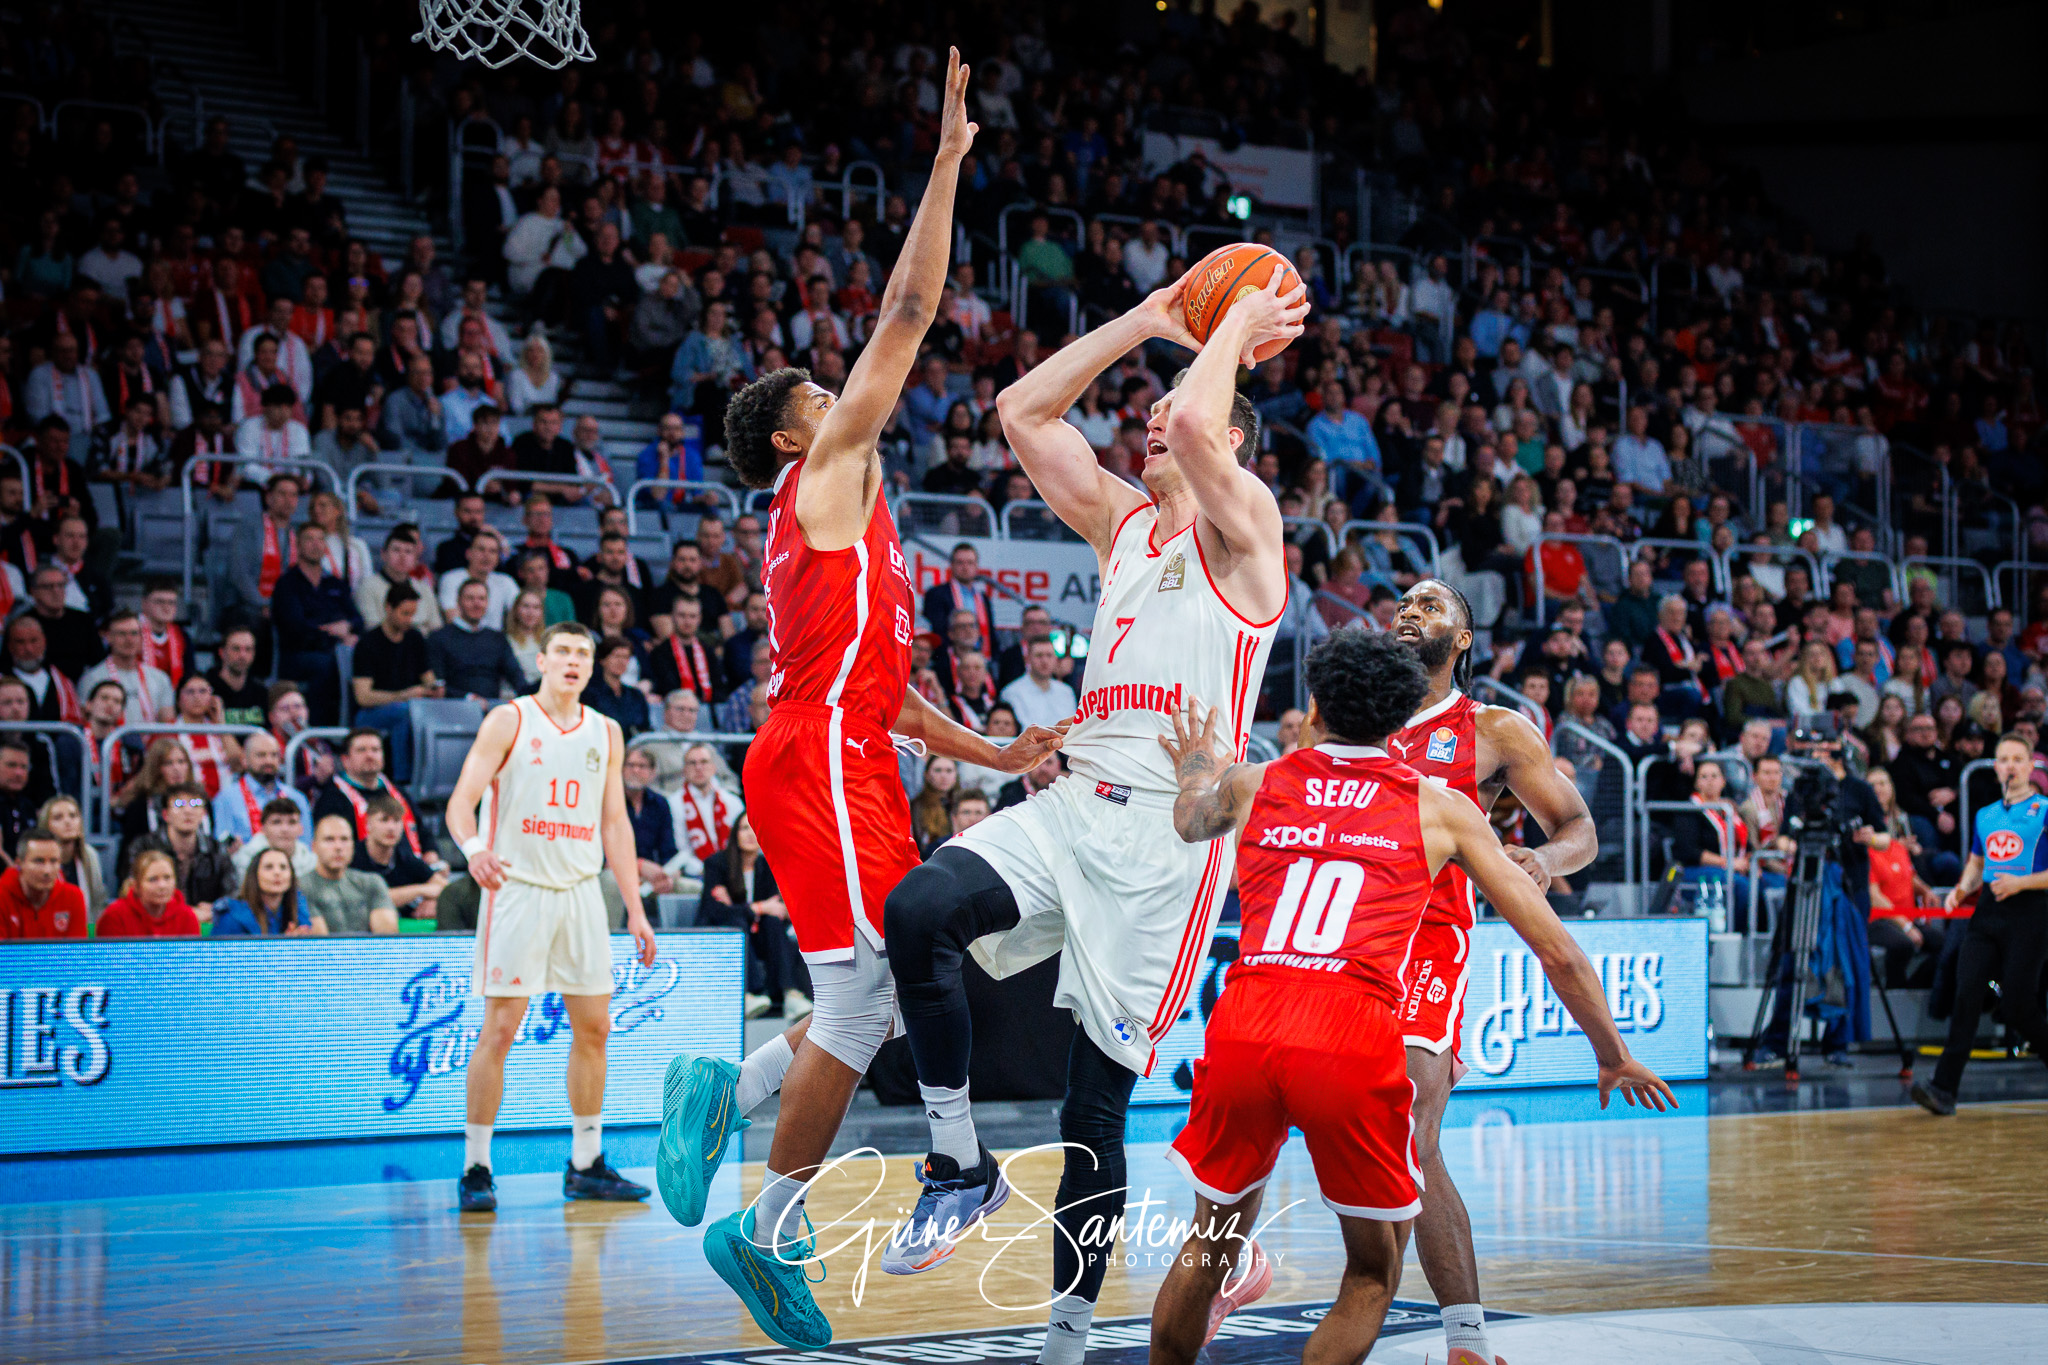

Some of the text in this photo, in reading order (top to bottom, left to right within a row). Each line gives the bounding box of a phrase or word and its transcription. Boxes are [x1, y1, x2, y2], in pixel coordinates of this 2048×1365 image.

[1188, 257, 1235, 330] Baden
[769, 550, 790, 575] gistics
[1107, 616, 1136, 664] 7
[546, 777, 581, 809] 10
[1305, 778, 1380, 809] SEGU
[521, 813, 596, 842] siegmund
[1259, 822, 1400, 851] xpd logistics
[1261, 856, 1366, 955] 10
